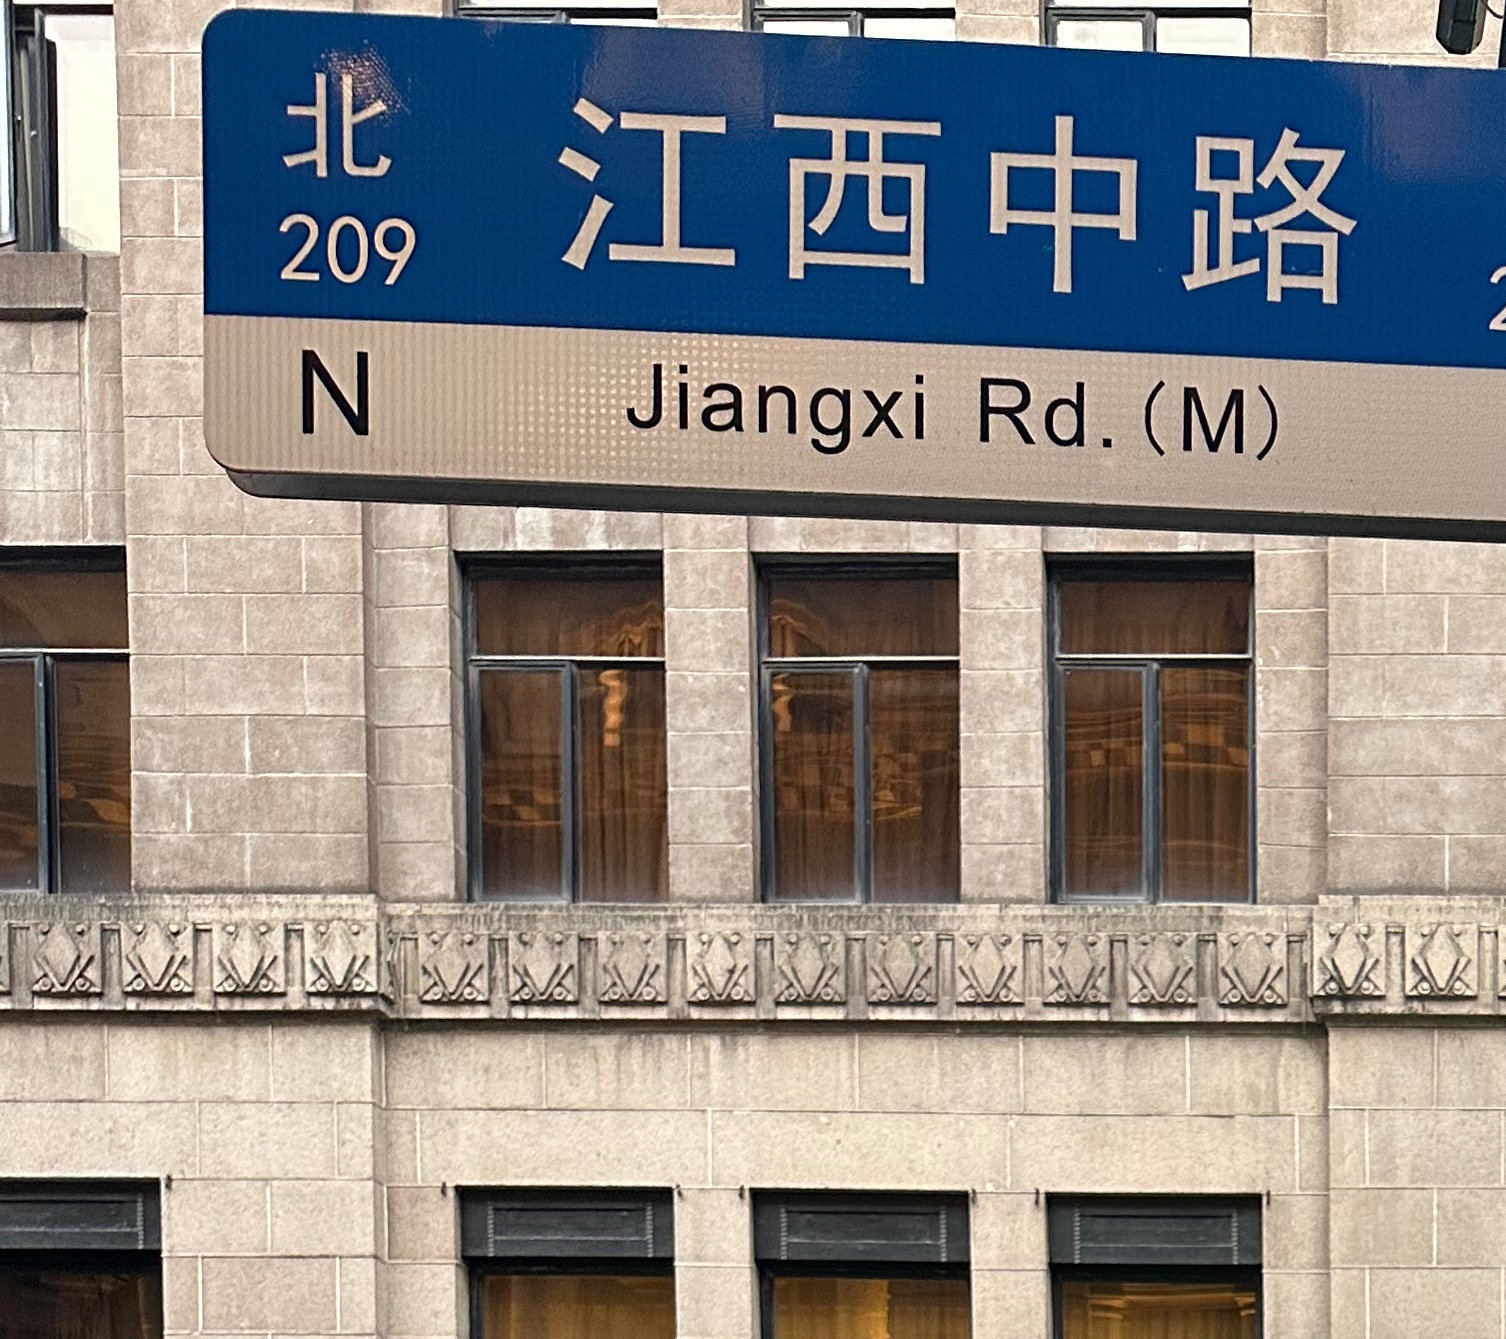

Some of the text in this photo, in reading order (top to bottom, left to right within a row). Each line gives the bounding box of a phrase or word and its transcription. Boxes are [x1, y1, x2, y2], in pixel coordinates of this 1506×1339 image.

[282, 71, 392, 179] 北
[558, 97, 1357, 305] 江西中路
[279, 213, 417, 286] 209
[301, 349, 369, 436] N
[626, 363, 925, 455] Jiangxi
